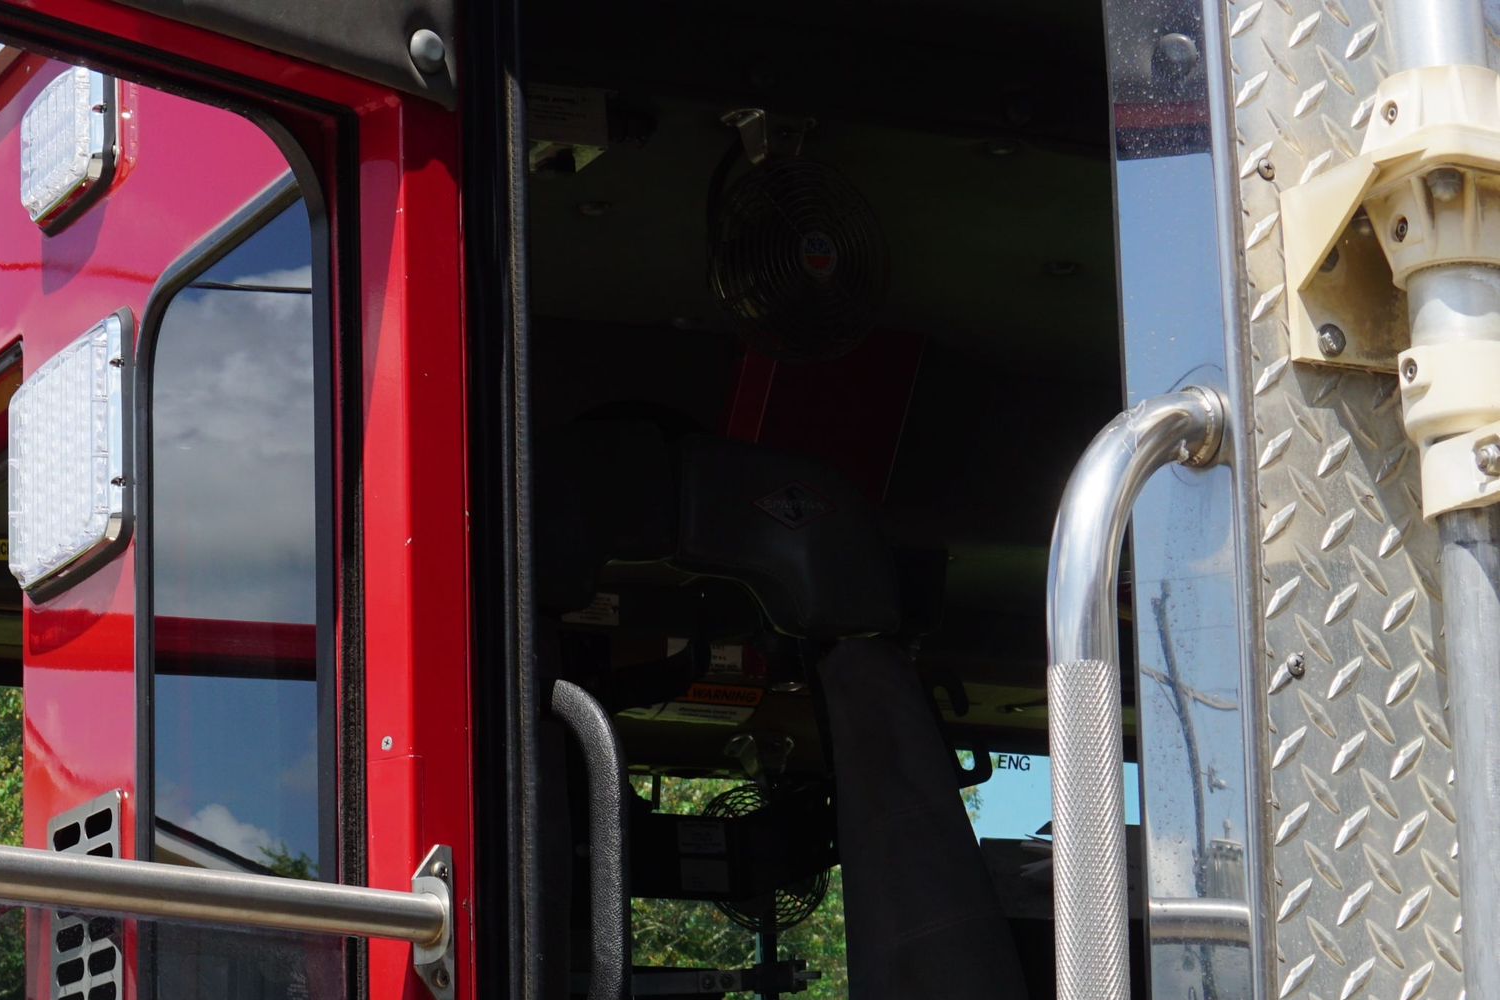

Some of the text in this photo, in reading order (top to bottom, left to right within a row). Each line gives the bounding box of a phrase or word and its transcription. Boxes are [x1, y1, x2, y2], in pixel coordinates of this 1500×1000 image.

[763, 499, 825, 511] SPARTAN
[692, 687, 757, 703] WARNING
[997, 754, 1030, 771] ENG
